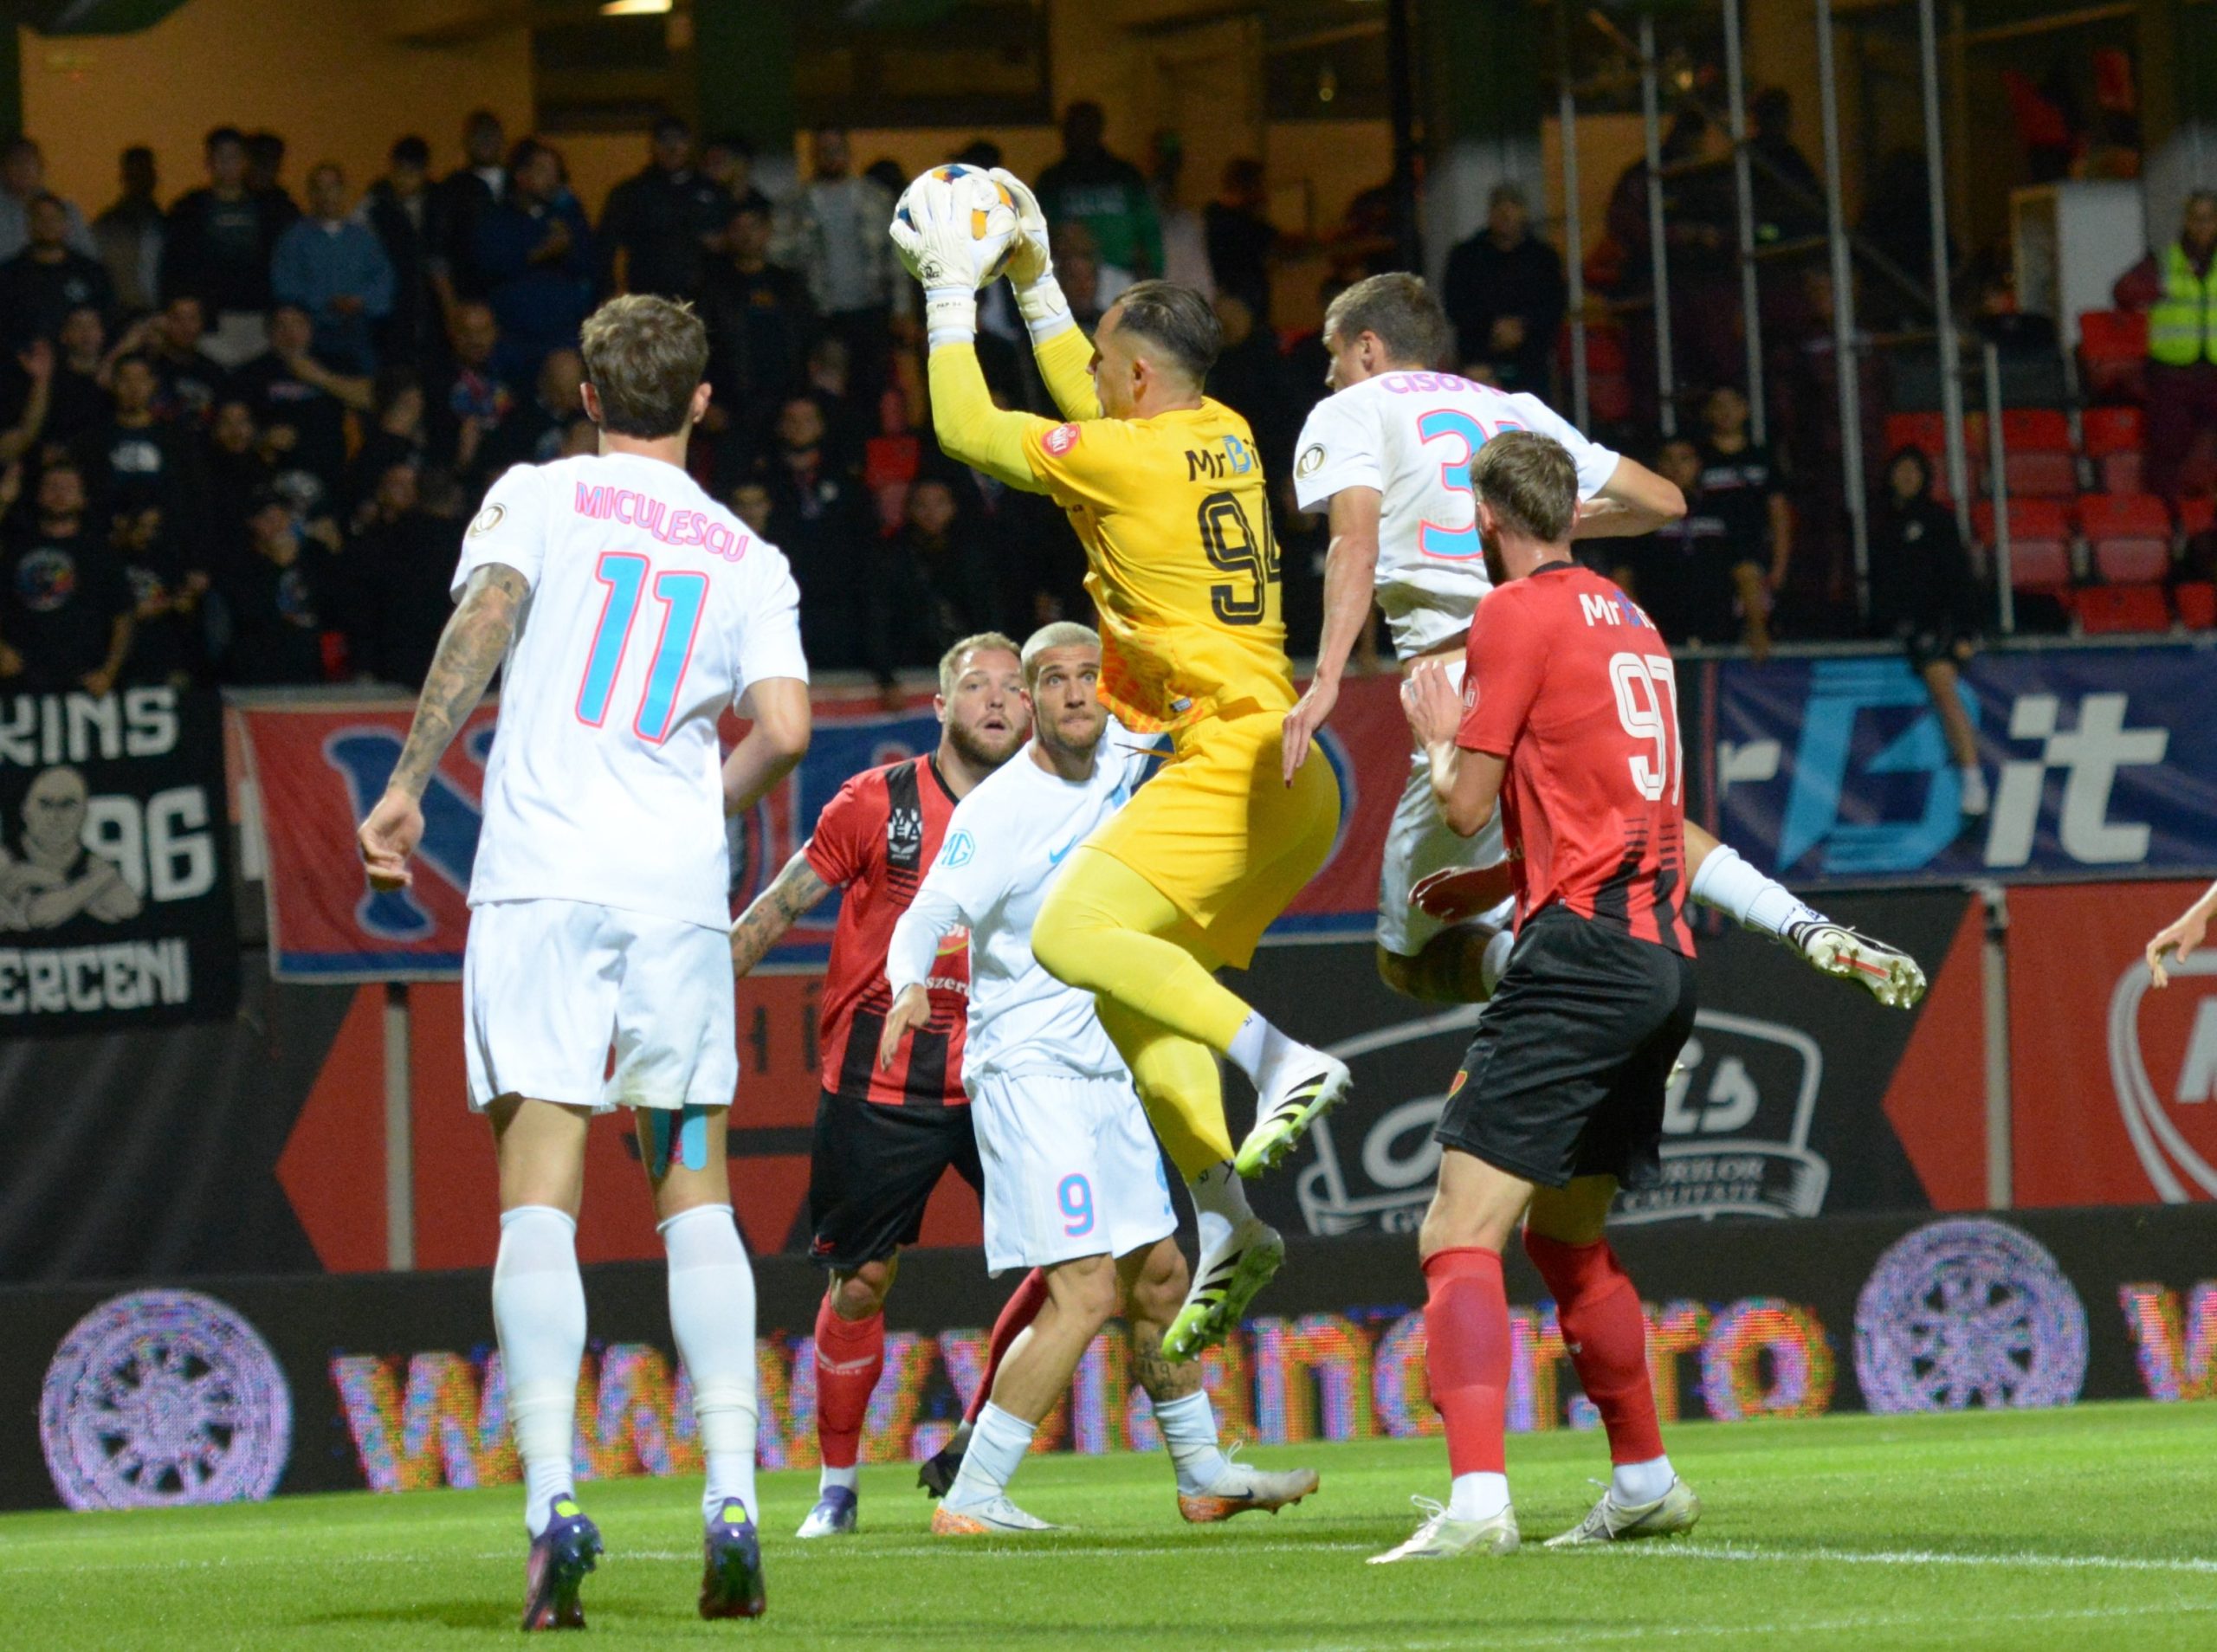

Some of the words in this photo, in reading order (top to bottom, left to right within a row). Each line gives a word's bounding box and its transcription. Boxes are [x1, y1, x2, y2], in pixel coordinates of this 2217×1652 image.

[1185, 435, 1259, 481] MrBi
[574, 481, 749, 563] MICULESCU
[575, 552, 710, 745] 11
[1609, 652, 1683, 806] 97
[82, 785, 216, 903] 96
[1057, 1172, 1096, 1238] 9
